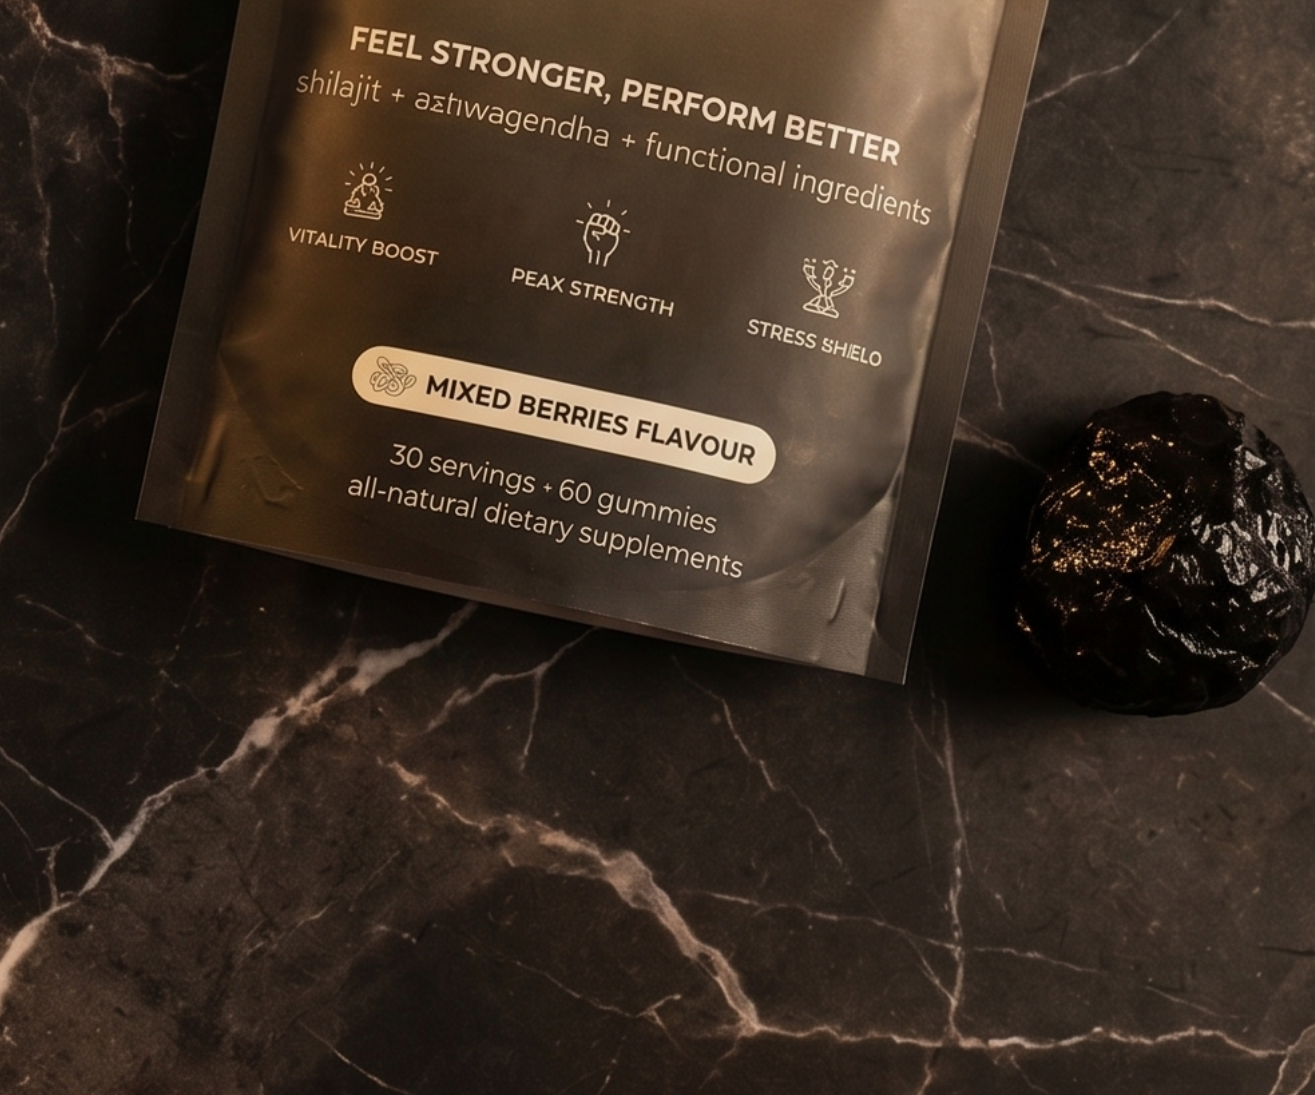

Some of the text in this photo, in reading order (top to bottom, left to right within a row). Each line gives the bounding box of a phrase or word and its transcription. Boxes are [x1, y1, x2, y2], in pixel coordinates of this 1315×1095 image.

[350, 25, 901, 166] FEEL STRONGER, PERFORM BETTER
[296, 68, 383, 107] shilajit
[645, 131, 786, 187] functional
[792, 163, 932, 226] ingredients
[288, 226, 440, 266] VITALITY BOOST
[569, 280, 674, 317] STRENGTH
[746, 318, 817, 350] STRESS
[425, 374, 756, 466] MIXED BERRIES FLAVOUR
[347, 475, 743, 579] all-natural dietary supplements
[389, 443, 424, 469] 30
[428, 455, 536, 496] servings
[558, 478, 592, 505] 60
[596, 492, 717, 534] gummies
